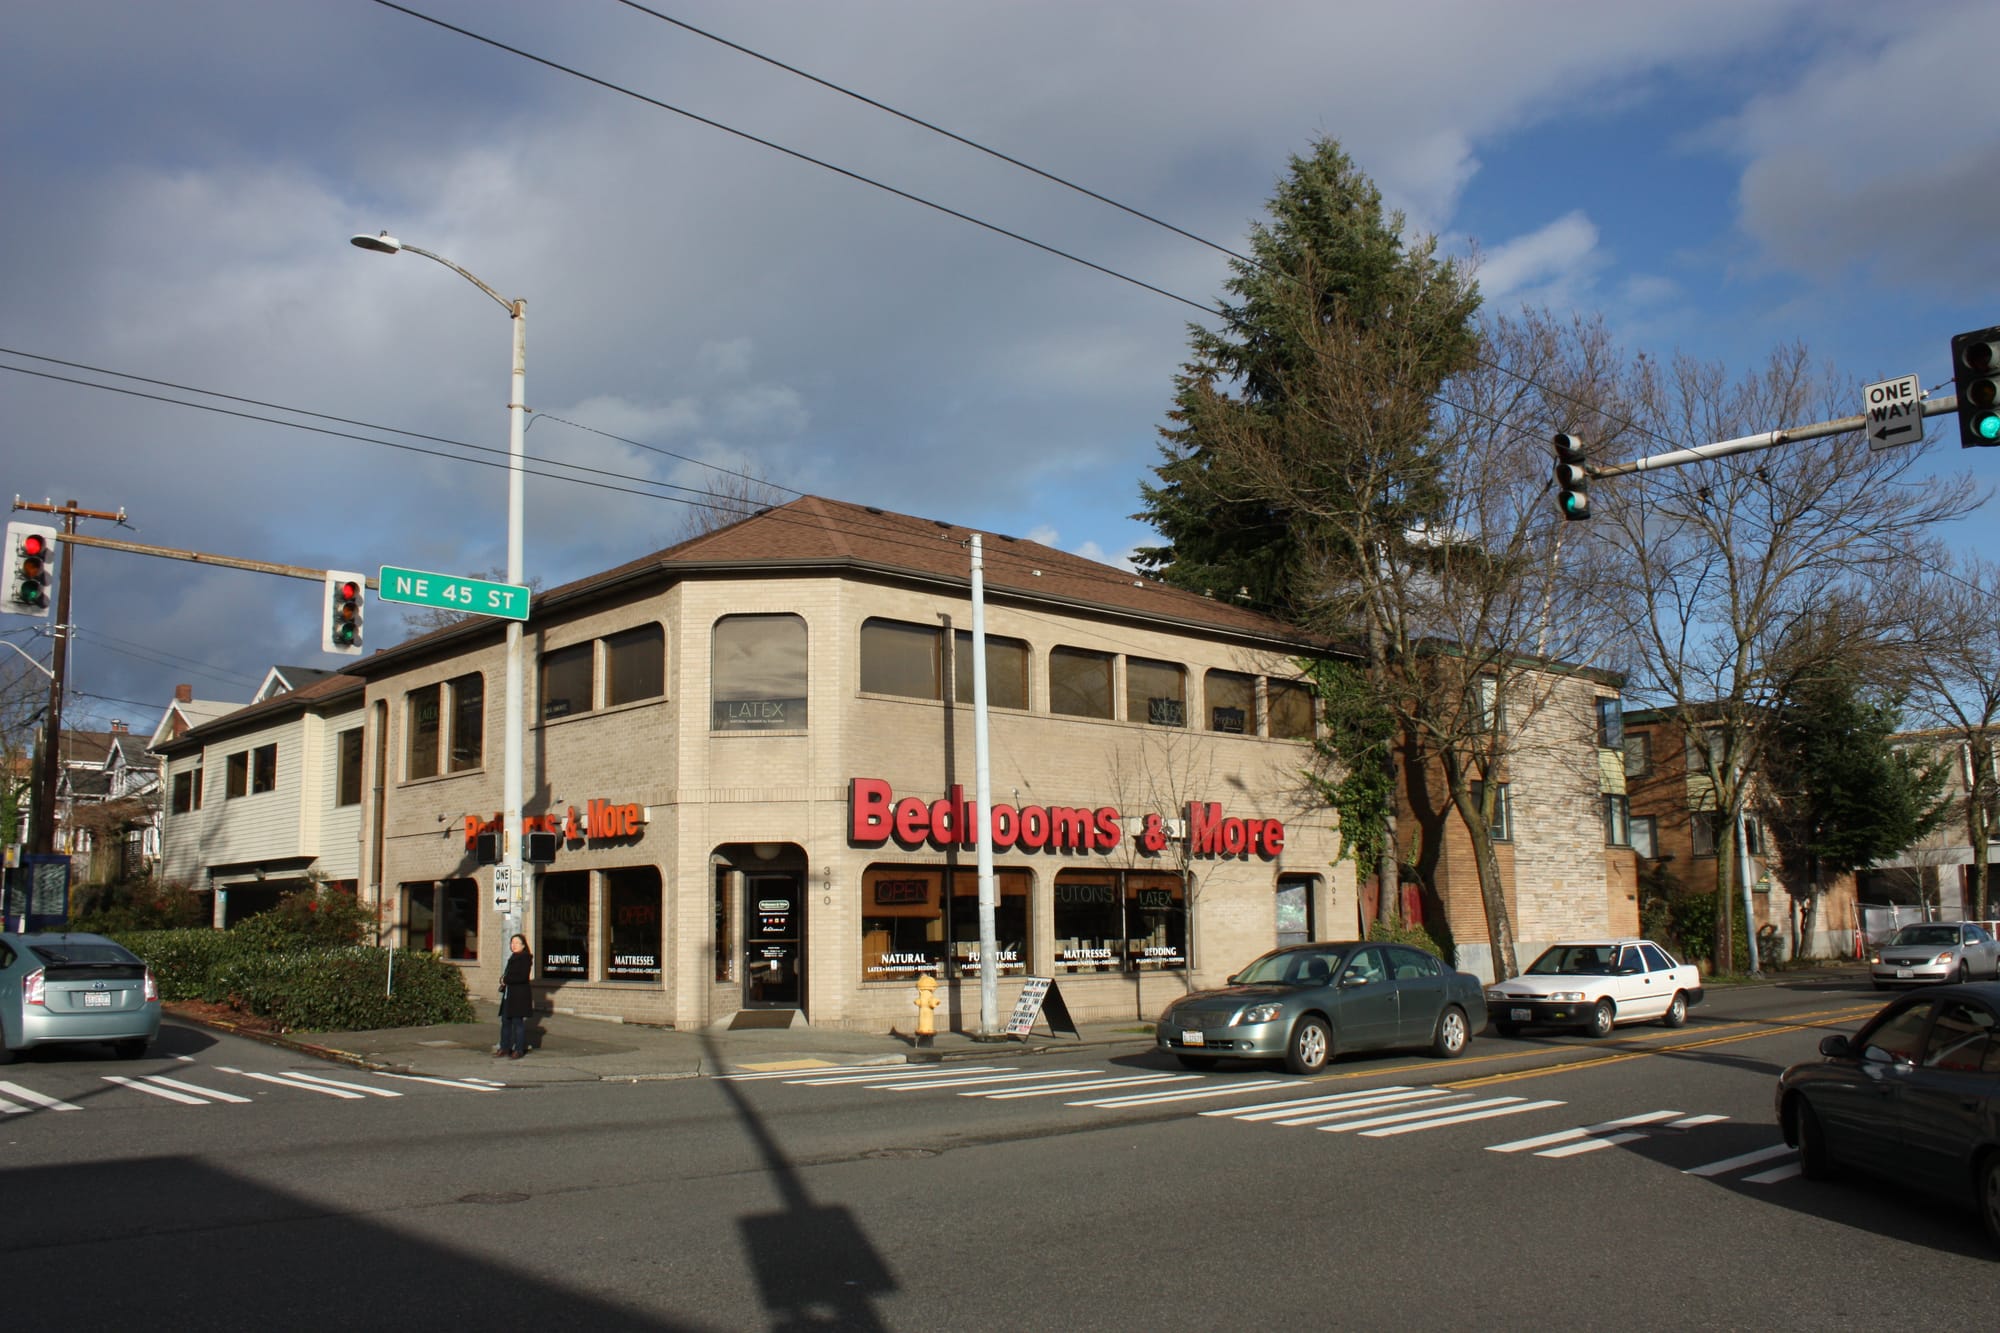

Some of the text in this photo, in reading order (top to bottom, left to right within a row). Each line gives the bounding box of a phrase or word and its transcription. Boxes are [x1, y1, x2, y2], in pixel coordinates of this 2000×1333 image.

[1870, 381, 1912, 404] ONE
[1871, 399, 1914, 423] WAY
[396, 576, 515, 609] NE 45 ST
[728, 702, 785, 718] LATEX
[565, 805, 578, 840] &
[587, 797, 640, 839] More
[1143, 812, 1168, 851] &
[1188, 800, 1285, 856] More
[496, 869, 509, 880] ONE
[496, 881, 509, 892] WAY
[878, 882, 929, 901] OPEN
[1139, 890, 1173, 906] LATEX
[881, 953, 926, 964] NATURAL
[968, 951, 1018, 962] FUTURE
[1063, 948, 1112, 959] MATTRESSES
[1144, 947, 1177, 957] BEDDING
[547, 954, 581, 965] FURNITURE
[614, 955, 655, 966] MATTRESSES
